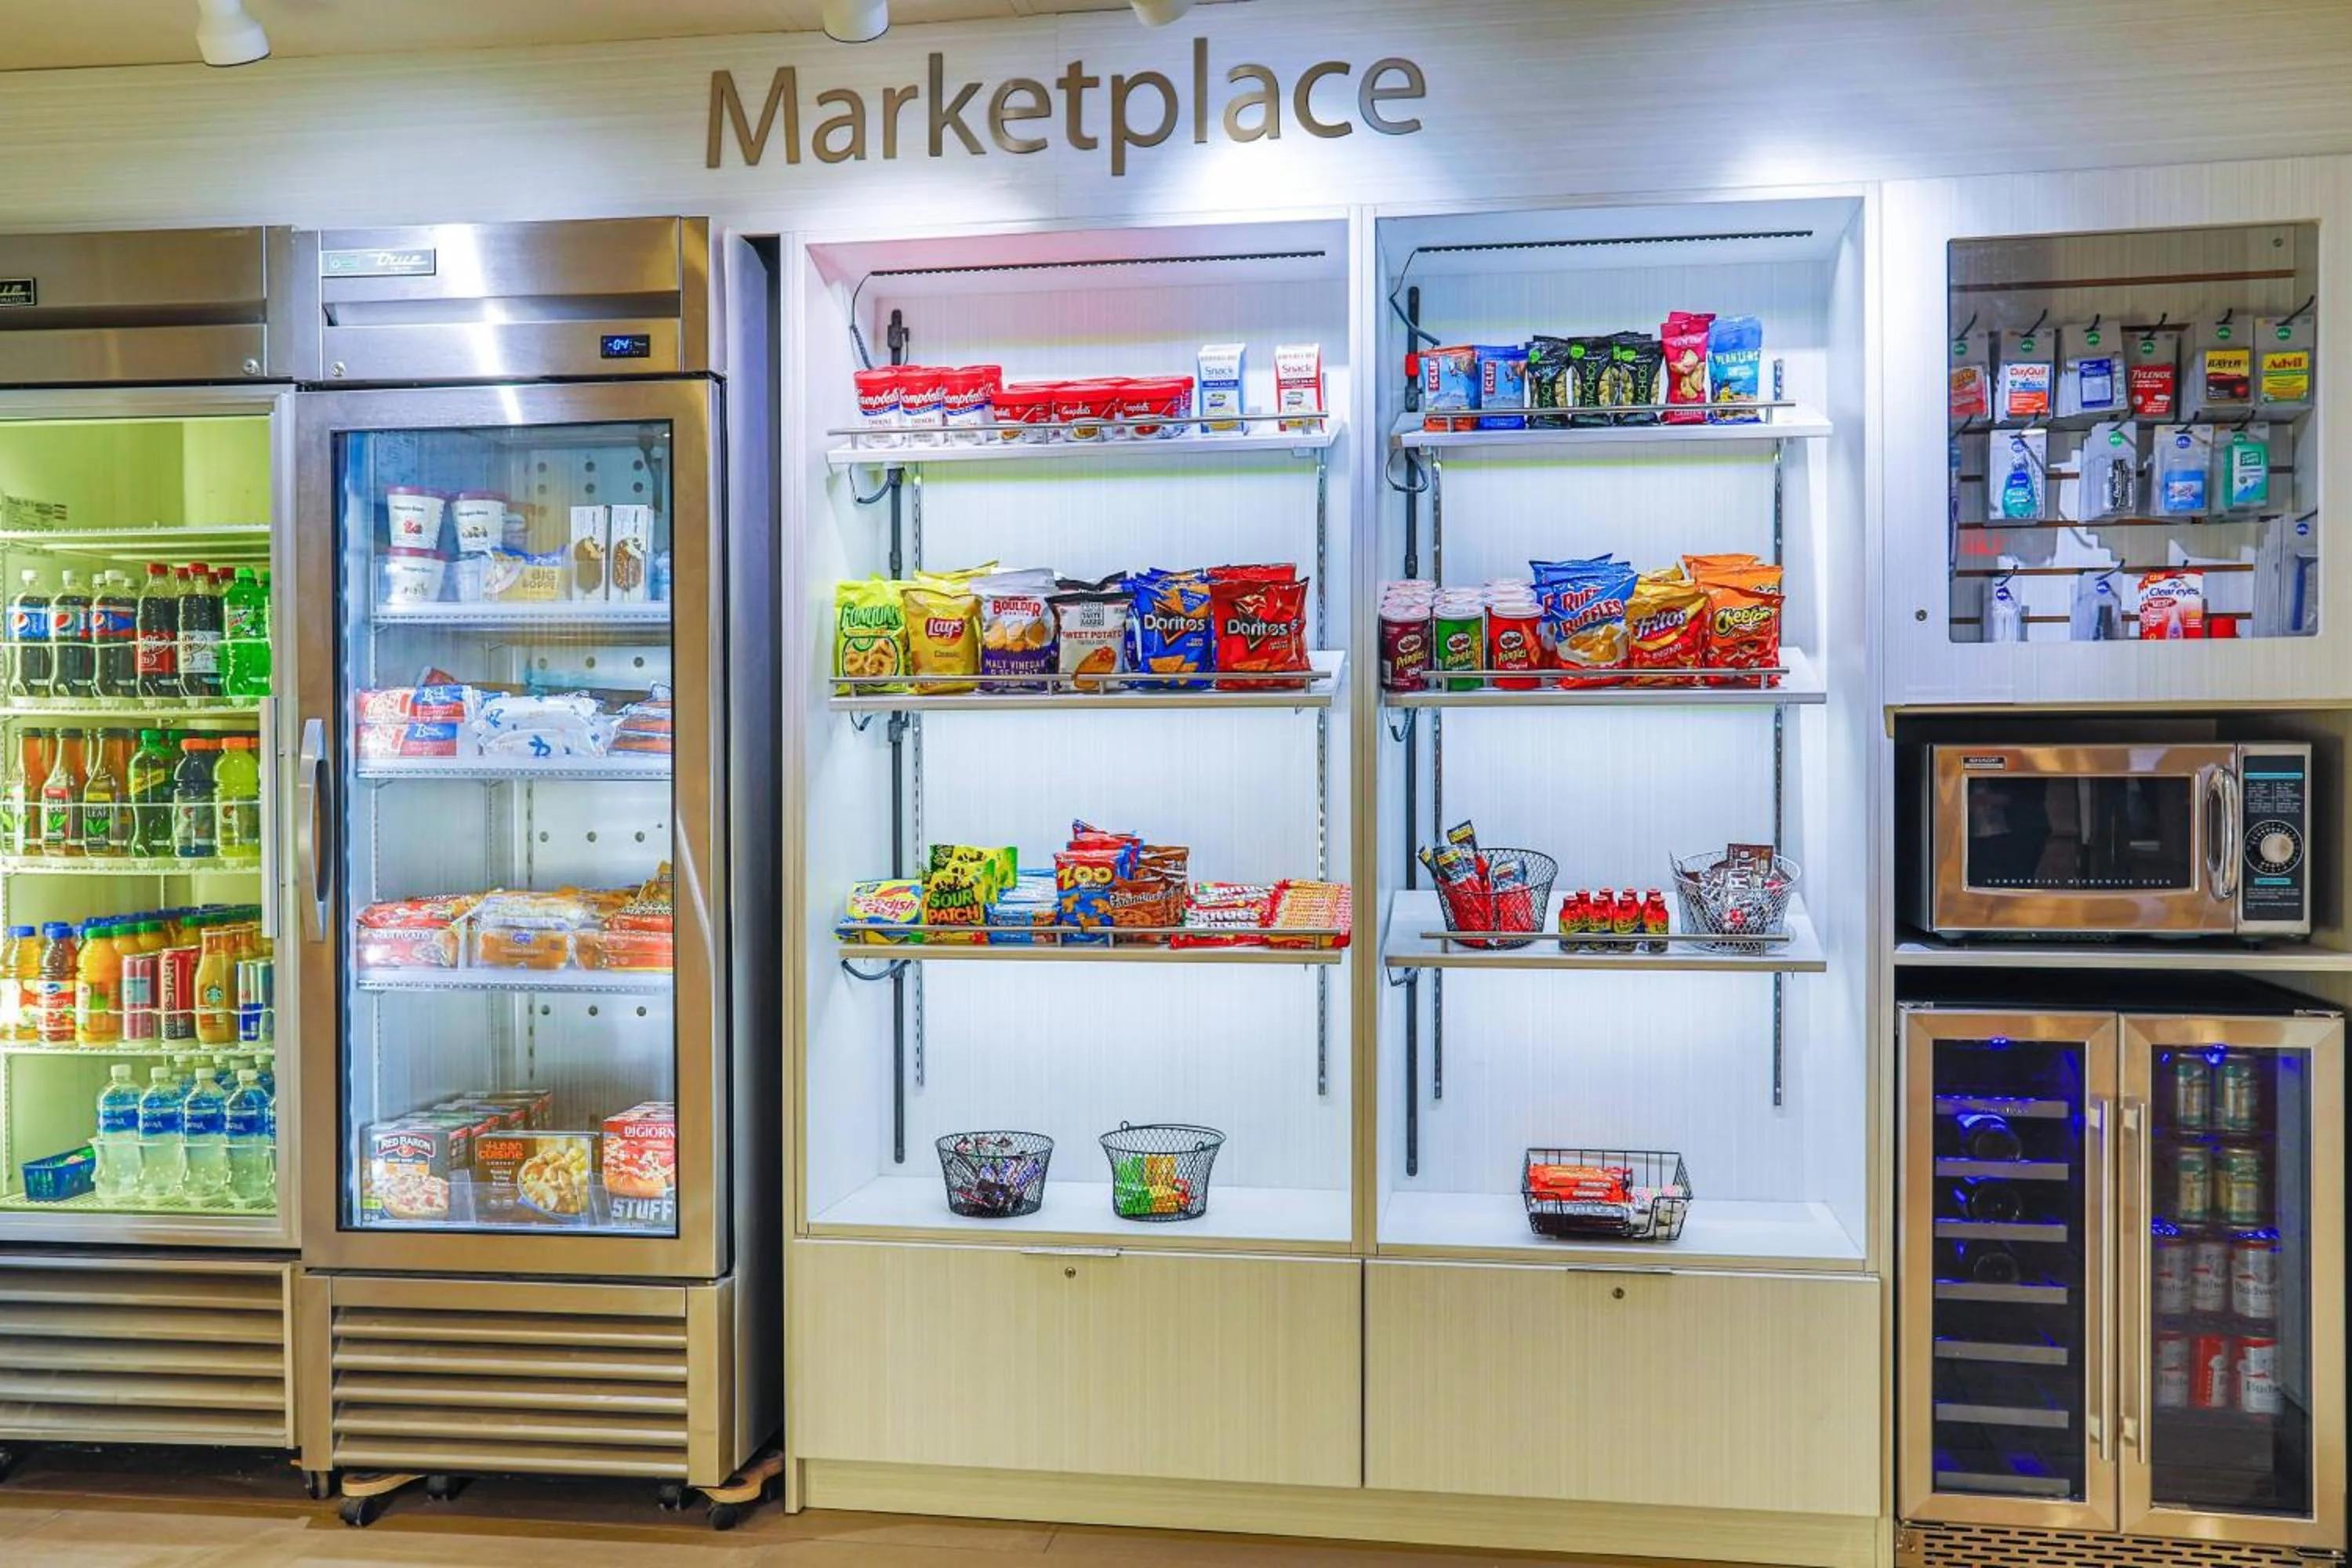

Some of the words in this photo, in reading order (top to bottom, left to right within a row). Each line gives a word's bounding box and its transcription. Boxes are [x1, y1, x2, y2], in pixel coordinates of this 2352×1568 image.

[706, 37, 1426, 176] Marketplace
[1205, 365, 1233, 375] Snack
[1283, 363, 1312, 372] Snack
[2268, 357, 2303, 368] Advil
[2150, 587, 2175, 596] Clear
[2176, 587, 2200, 597] eyes
[993, 601, 1041, 616] BOULDER
[1145, 614, 1205, 631] Doritos
[1561, 599, 1624, 637] RUFFLES
[1227, 619, 1288, 636] Doritos
[985, 659, 1007, 670] MALT
[1011, 659, 1046, 670] VINEGAR
[1058, 866, 1112, 890] ZOO
[931, 889, 975, 908] SOUR
[928, 904, 978, 924] PATCH
[624, 1126, 675, 1138] DIGIORN
[381, 1138, 399, 1150] RED
[612, 1197, 674, 1220] STUFF
